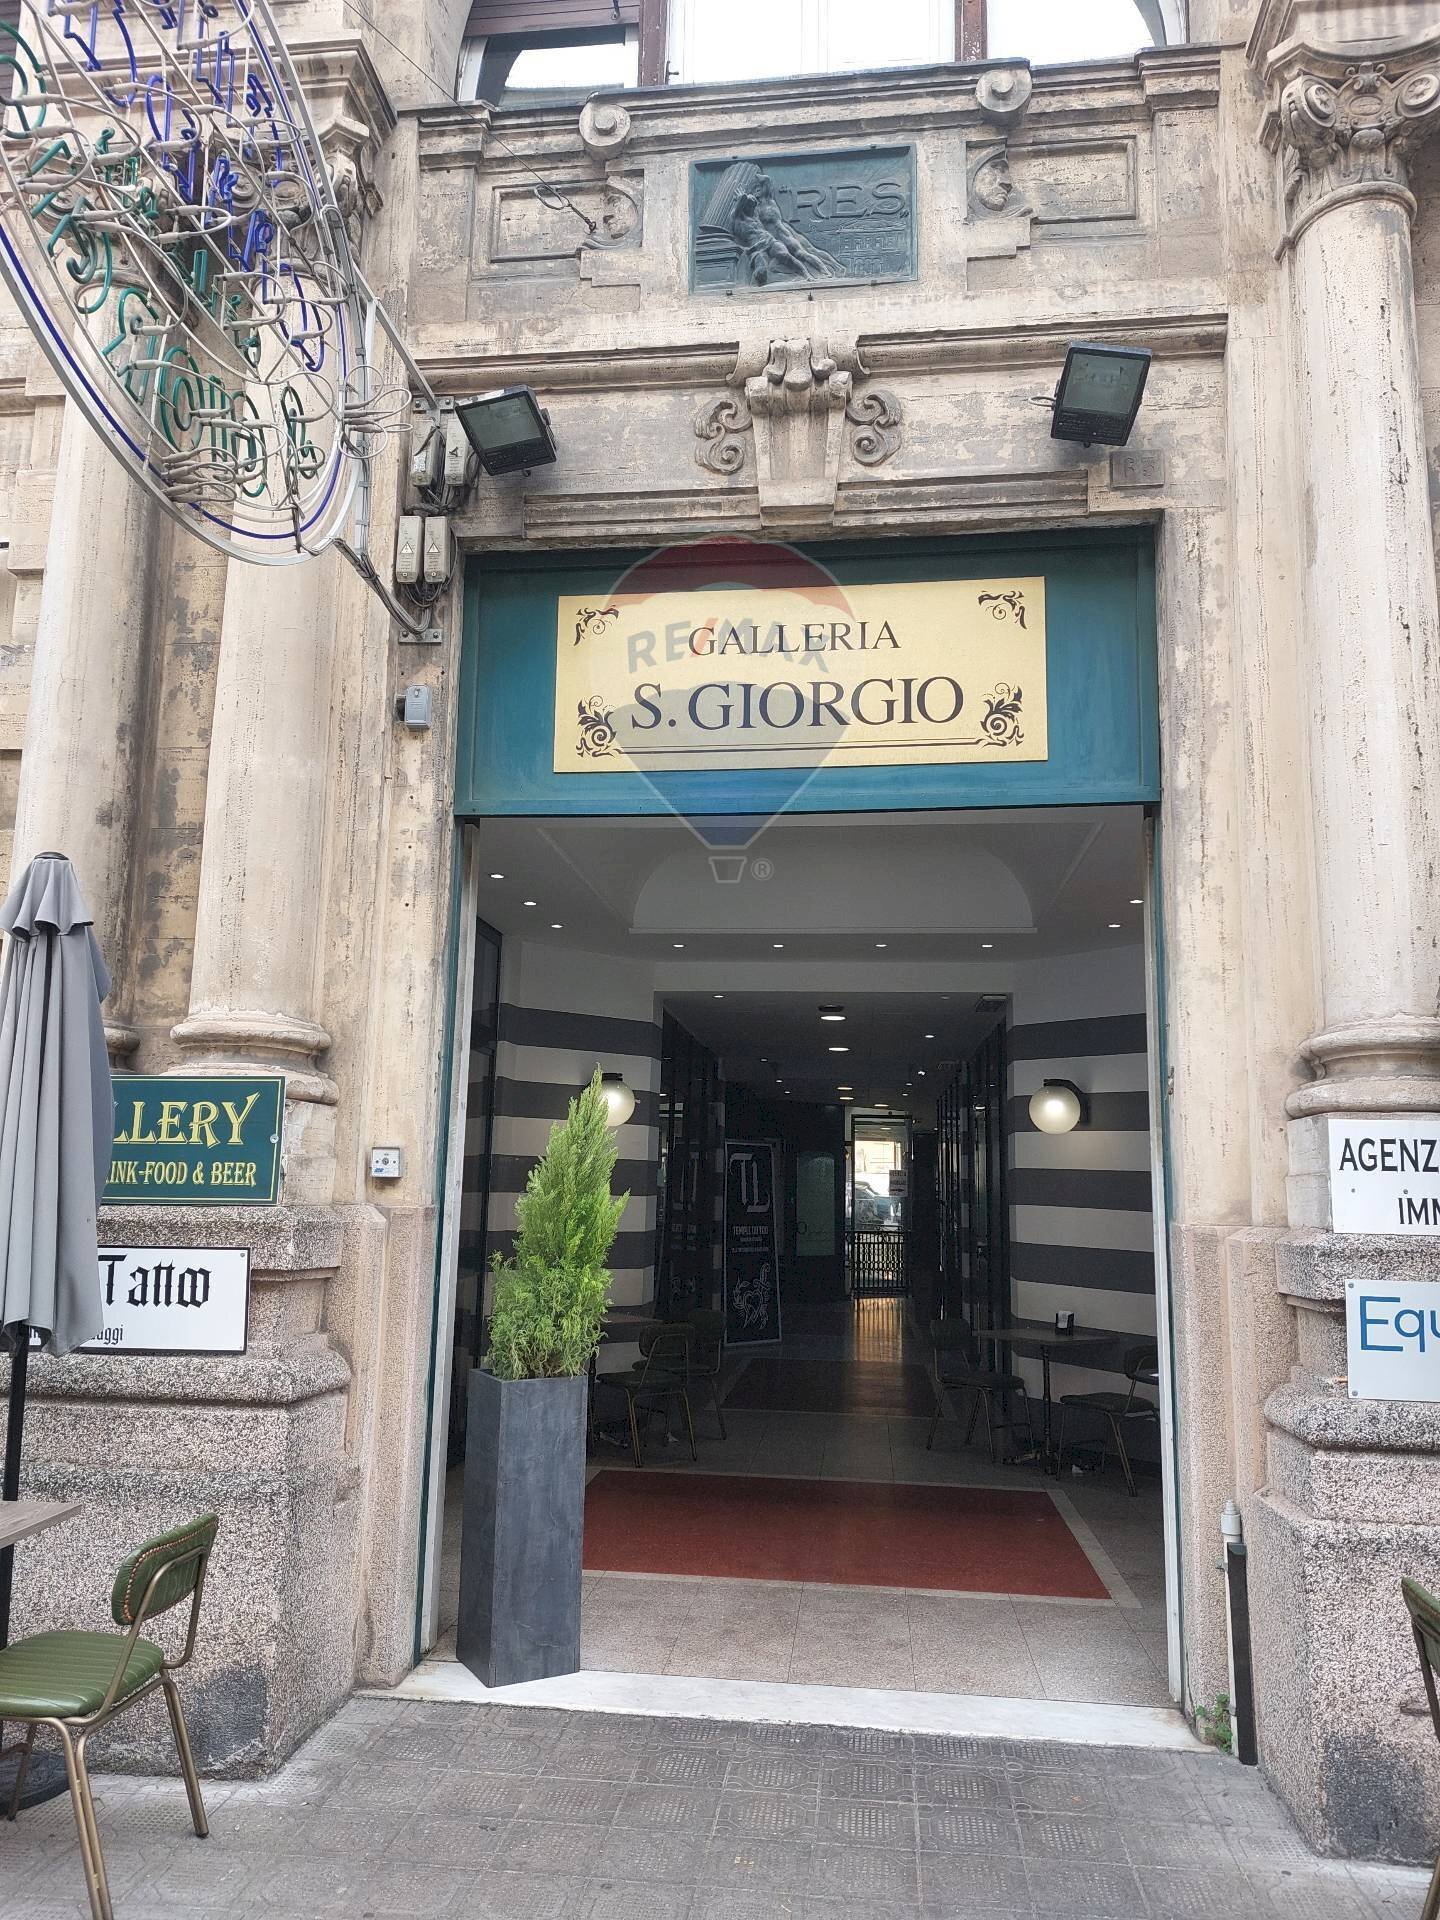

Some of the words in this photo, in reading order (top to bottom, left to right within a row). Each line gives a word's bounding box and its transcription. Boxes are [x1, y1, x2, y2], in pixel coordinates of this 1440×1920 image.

[688, 621, 901, 656] GALLERIA
[192, 1161, 205, 1185] &
[210, 1161, 257, 1188] BEER
